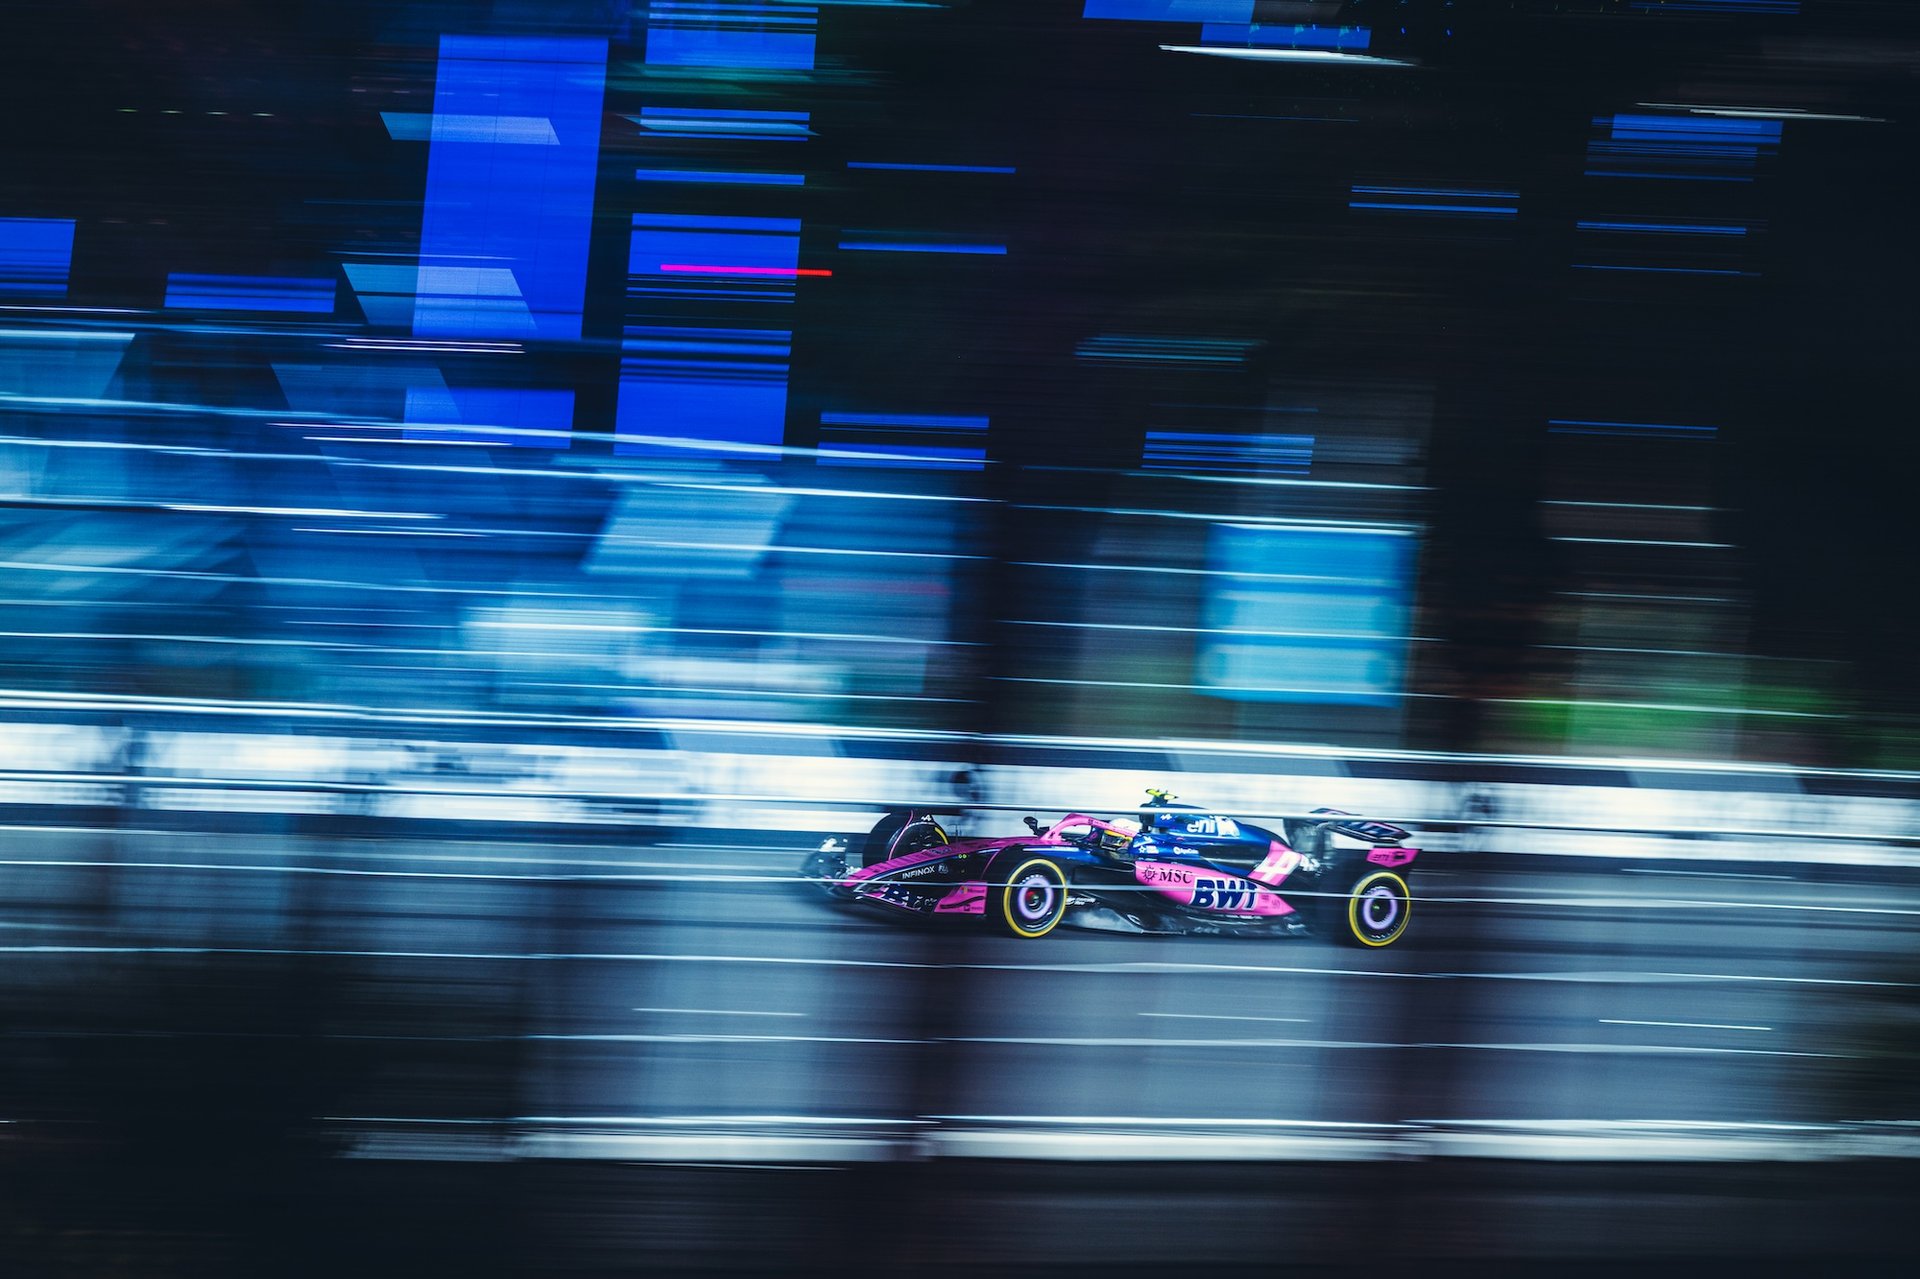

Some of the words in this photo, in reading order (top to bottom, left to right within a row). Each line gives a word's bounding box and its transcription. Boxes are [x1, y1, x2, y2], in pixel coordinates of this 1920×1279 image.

[1186, 816, 1216, 834] eni
[902, 865, 936, 880] INFINOX
[1159, 868, 1193, 884] MSC
[1189, 878, 1260, 910] BWT
